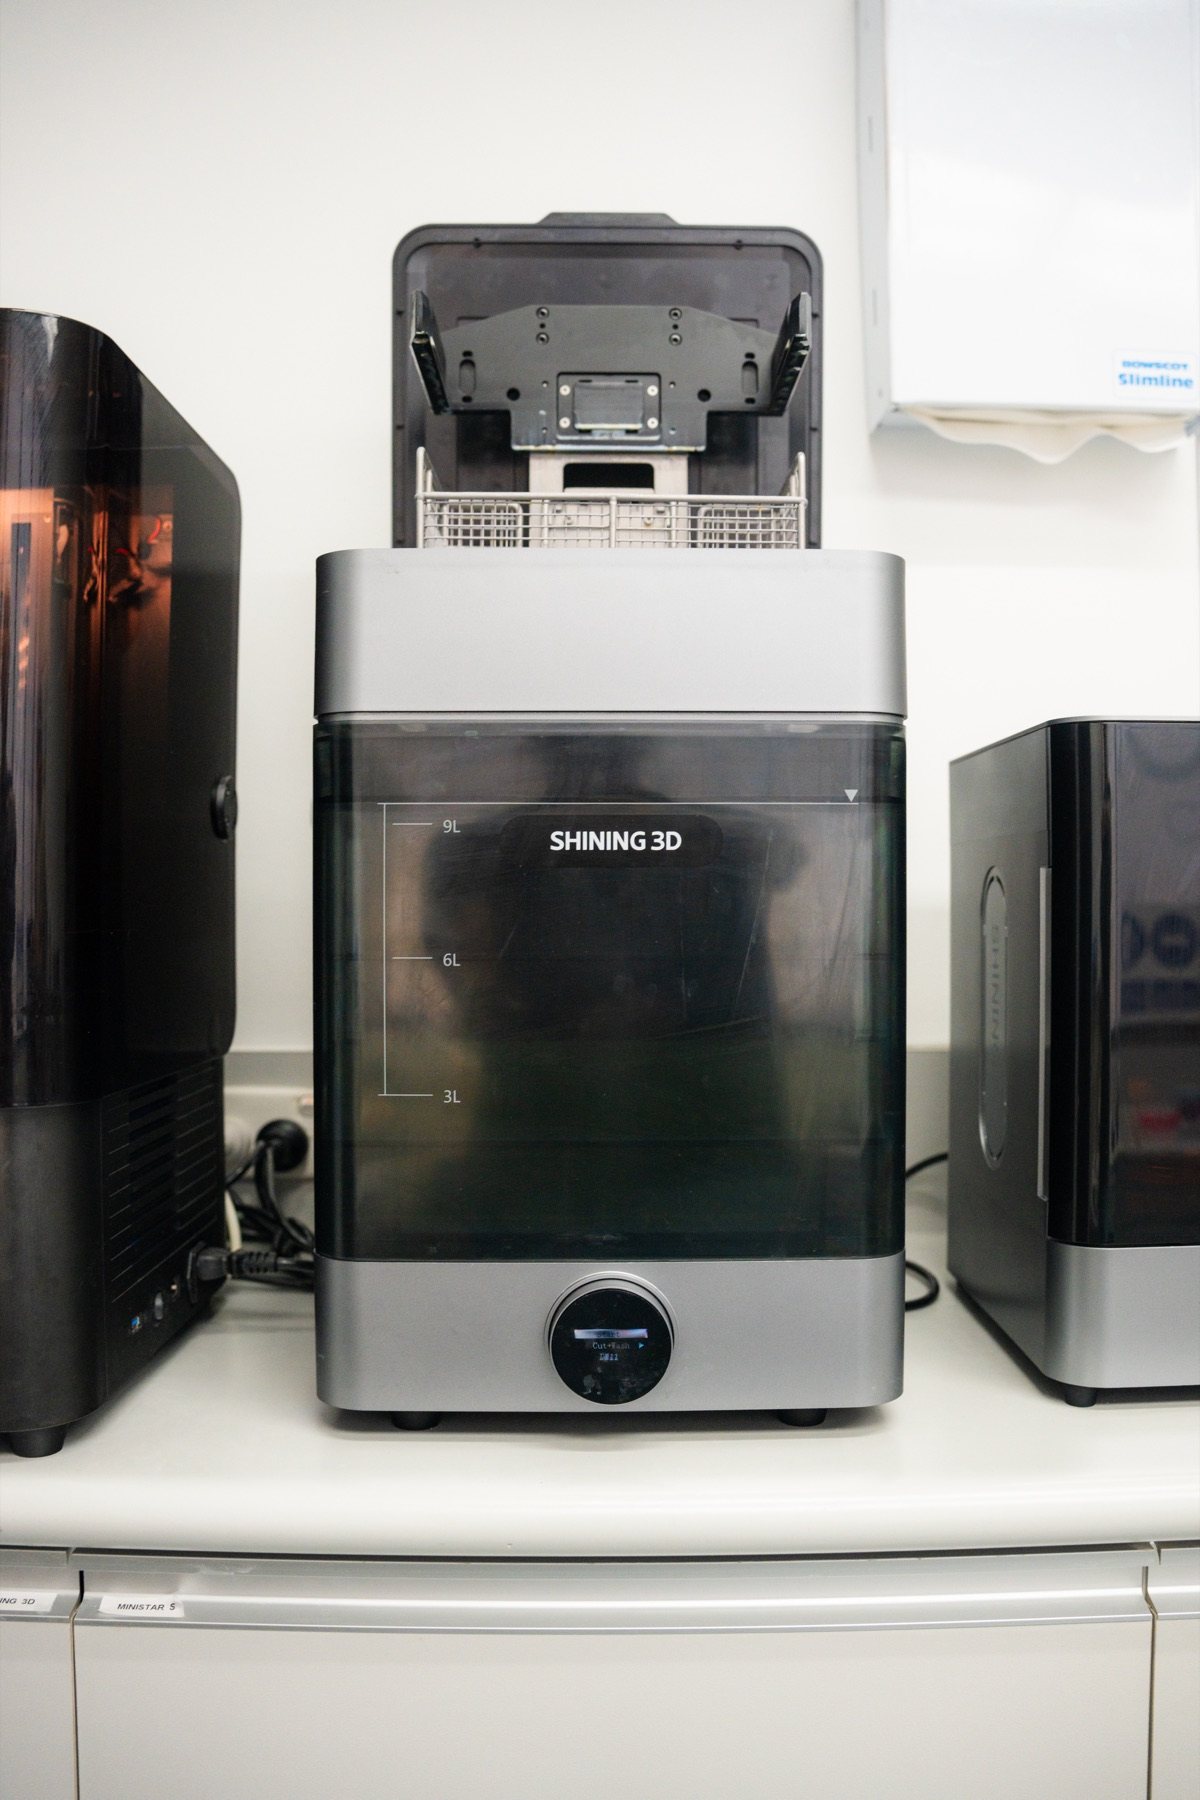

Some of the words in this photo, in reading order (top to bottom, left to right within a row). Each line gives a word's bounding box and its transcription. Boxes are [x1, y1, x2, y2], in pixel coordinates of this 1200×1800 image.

[1119, 373, 1193, 388] Slimline
[443, 819, 461, 833] 9L
[550, 830, 646, 851] SHINING
[650, 830, 682, 851] 3D
[443, 953, 461, 967] 6L
[443, 1089, 461, 1103] 3L
[117, 1602, 165, 1611] MINISTAR
